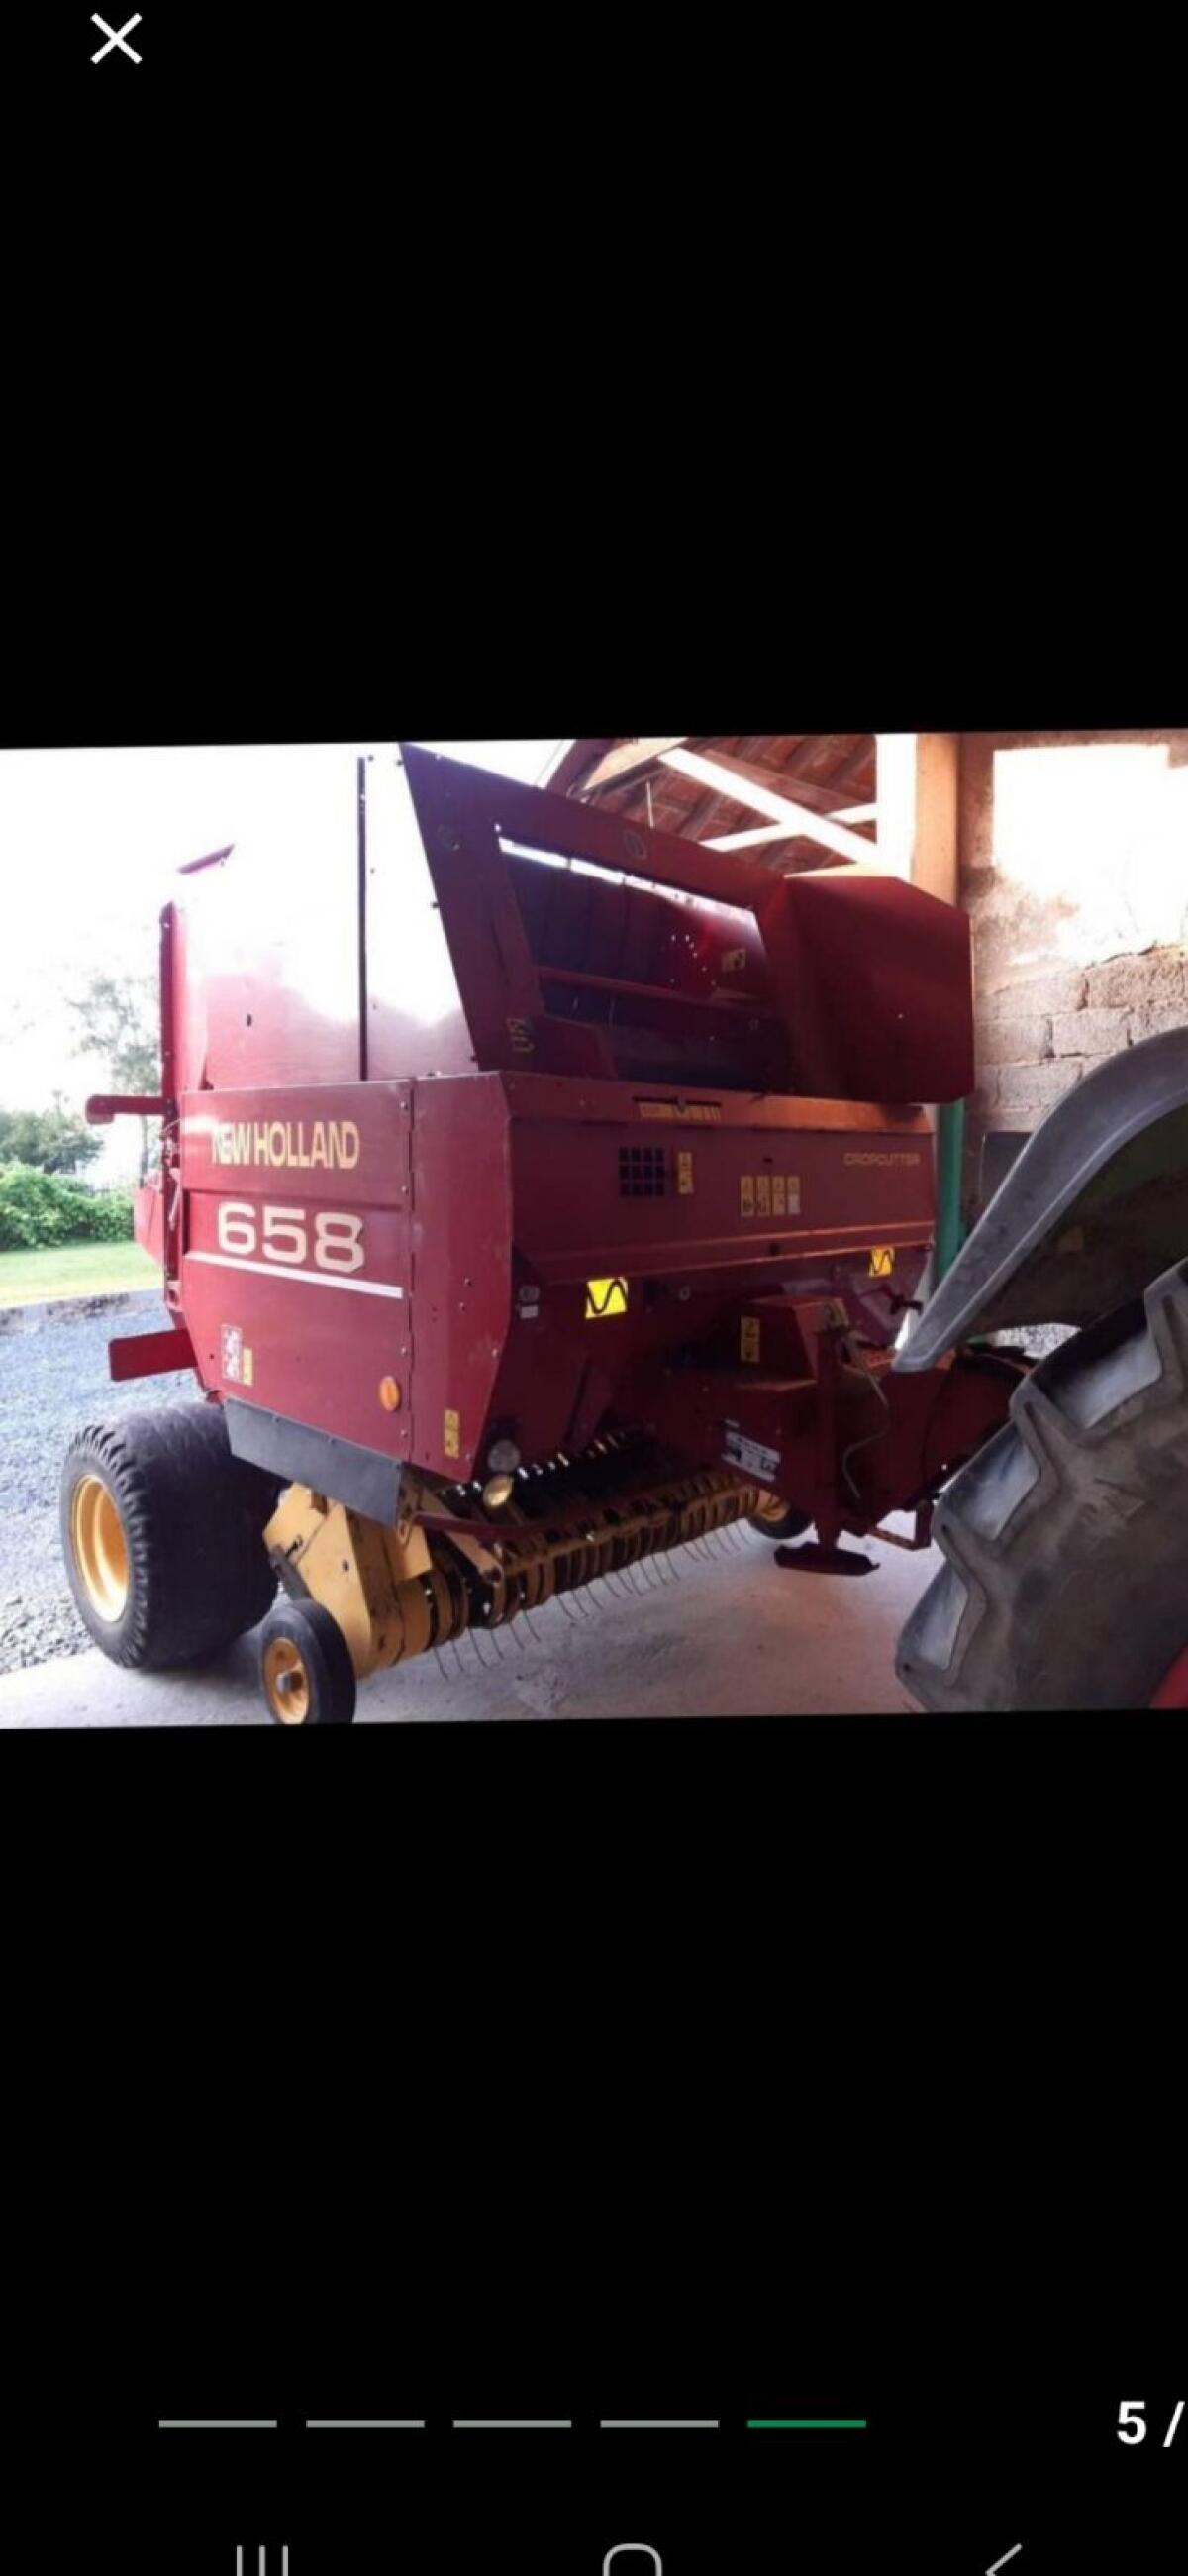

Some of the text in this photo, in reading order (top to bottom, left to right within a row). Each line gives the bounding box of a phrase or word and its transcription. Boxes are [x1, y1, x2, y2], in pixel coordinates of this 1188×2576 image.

[212, 1121, 360, 1169] NEW HOLLAND
[218, 1201, 365, 1273] 658
